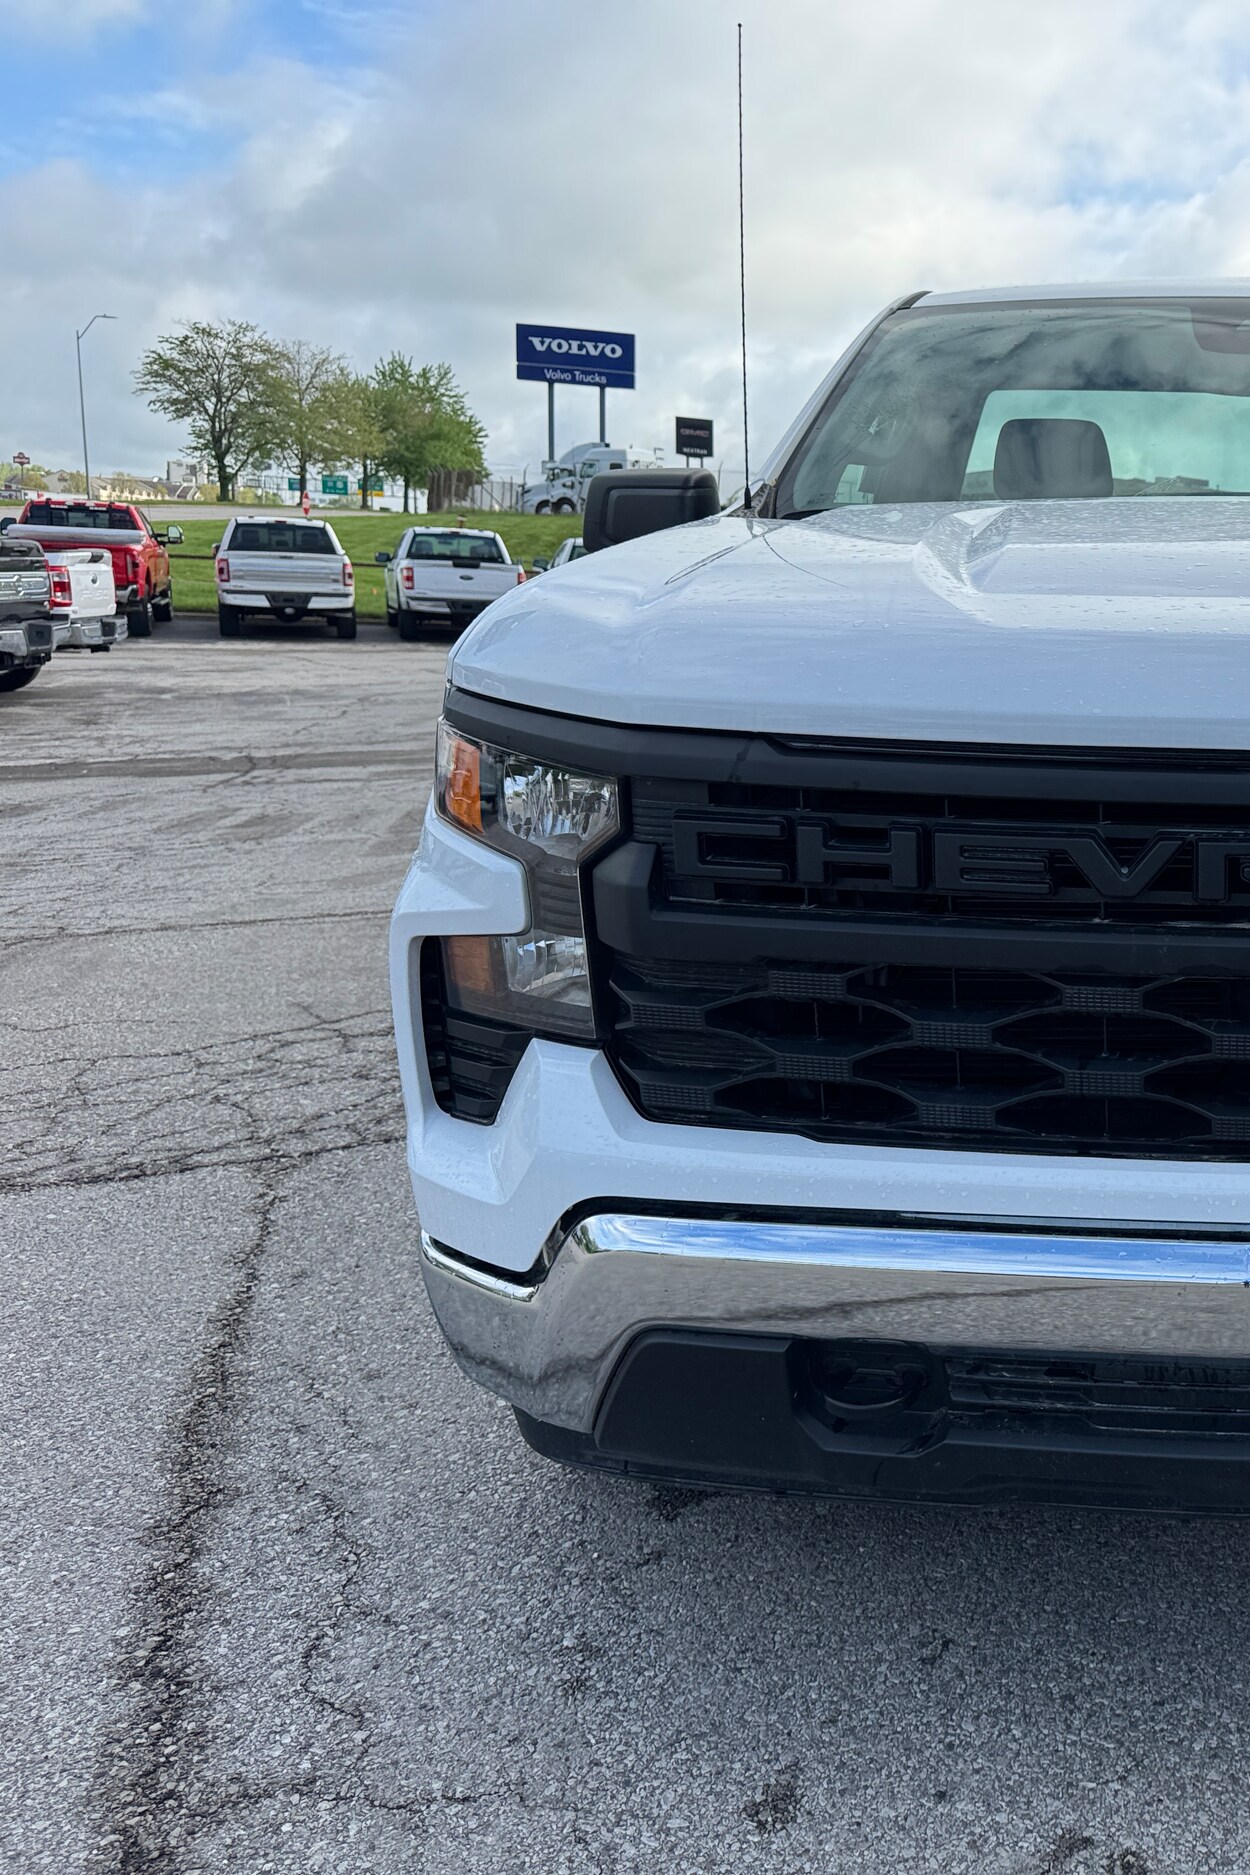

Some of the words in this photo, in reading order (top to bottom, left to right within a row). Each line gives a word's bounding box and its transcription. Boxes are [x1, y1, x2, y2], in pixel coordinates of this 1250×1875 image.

[528, 336, 623, 359] VOLVO
[544, 368, 572, 381] Volvo
[574, 370, 607, 384] Trucks
